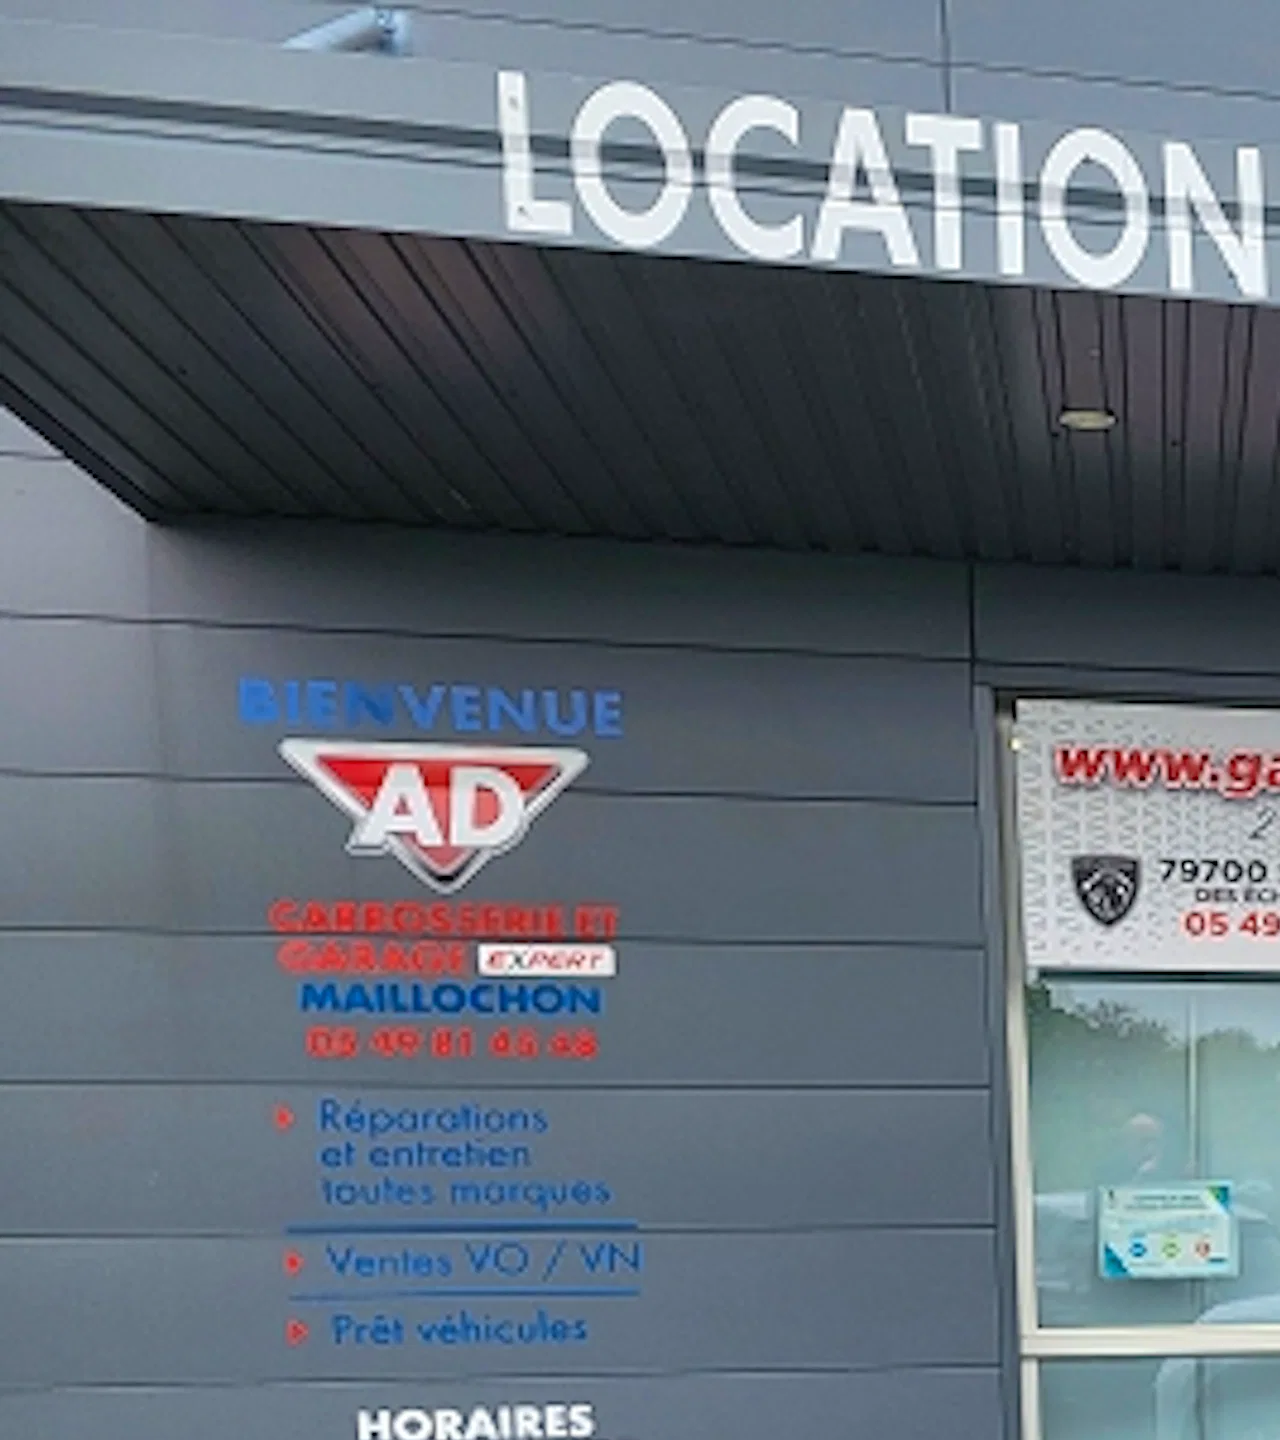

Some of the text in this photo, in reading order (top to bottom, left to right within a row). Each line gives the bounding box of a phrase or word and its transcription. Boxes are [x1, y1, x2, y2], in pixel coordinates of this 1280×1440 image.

[496, 69, 1269, 299] LOCATION
[238, 676, 624, 738] BIENVENUE
[349, 762, 526, 850] AD
[1158, 858, 1267, 885] 79700
[267, 899, 620, 940] CARROSSERIE ET
[1184, 911, 1229, 937] 05
[277, 940, 466, 975] GARAGE
[300, 982, 602, 1015] MAILLOCHON
[319, 1099, 549, 1139] Réparations
[320, 1139, 531, 1170] et entretien
[321, 1177, 613, 1211] toutes marques
[325, 1244, 453, 1278] Ventes
[465, 1241, 529, 1276] VO
[580, 1241, 644, 1275] VN
[330, 1310, 589, 1346] Prêt véhicules
